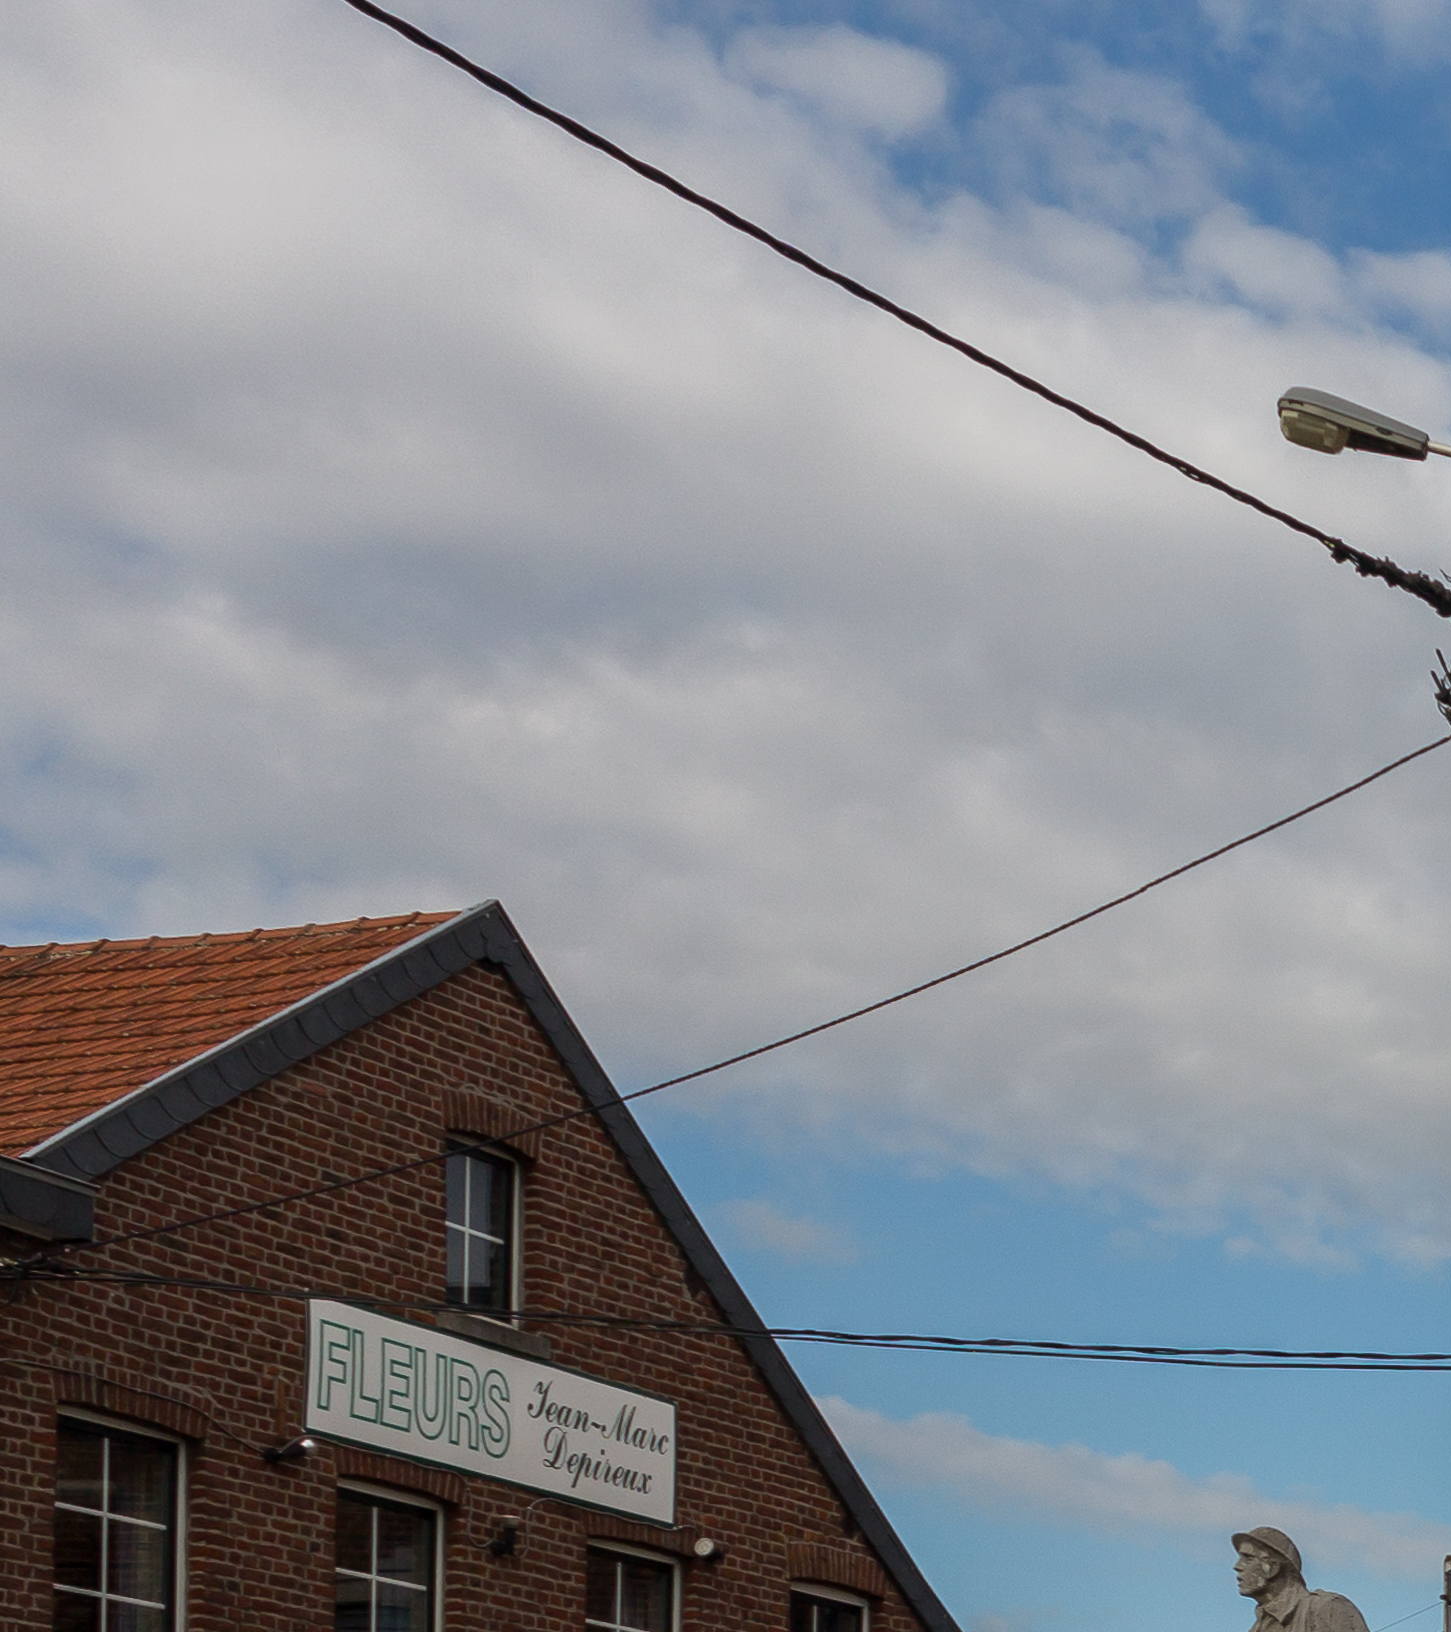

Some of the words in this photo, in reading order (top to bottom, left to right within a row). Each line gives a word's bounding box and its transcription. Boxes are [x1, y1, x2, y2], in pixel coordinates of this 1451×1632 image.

[317, 1319, 511, 1459] FLEURS
[527, 1380, 670, 1455] Jean-Marc
[542, 1426, 653, 1495] Depireux
